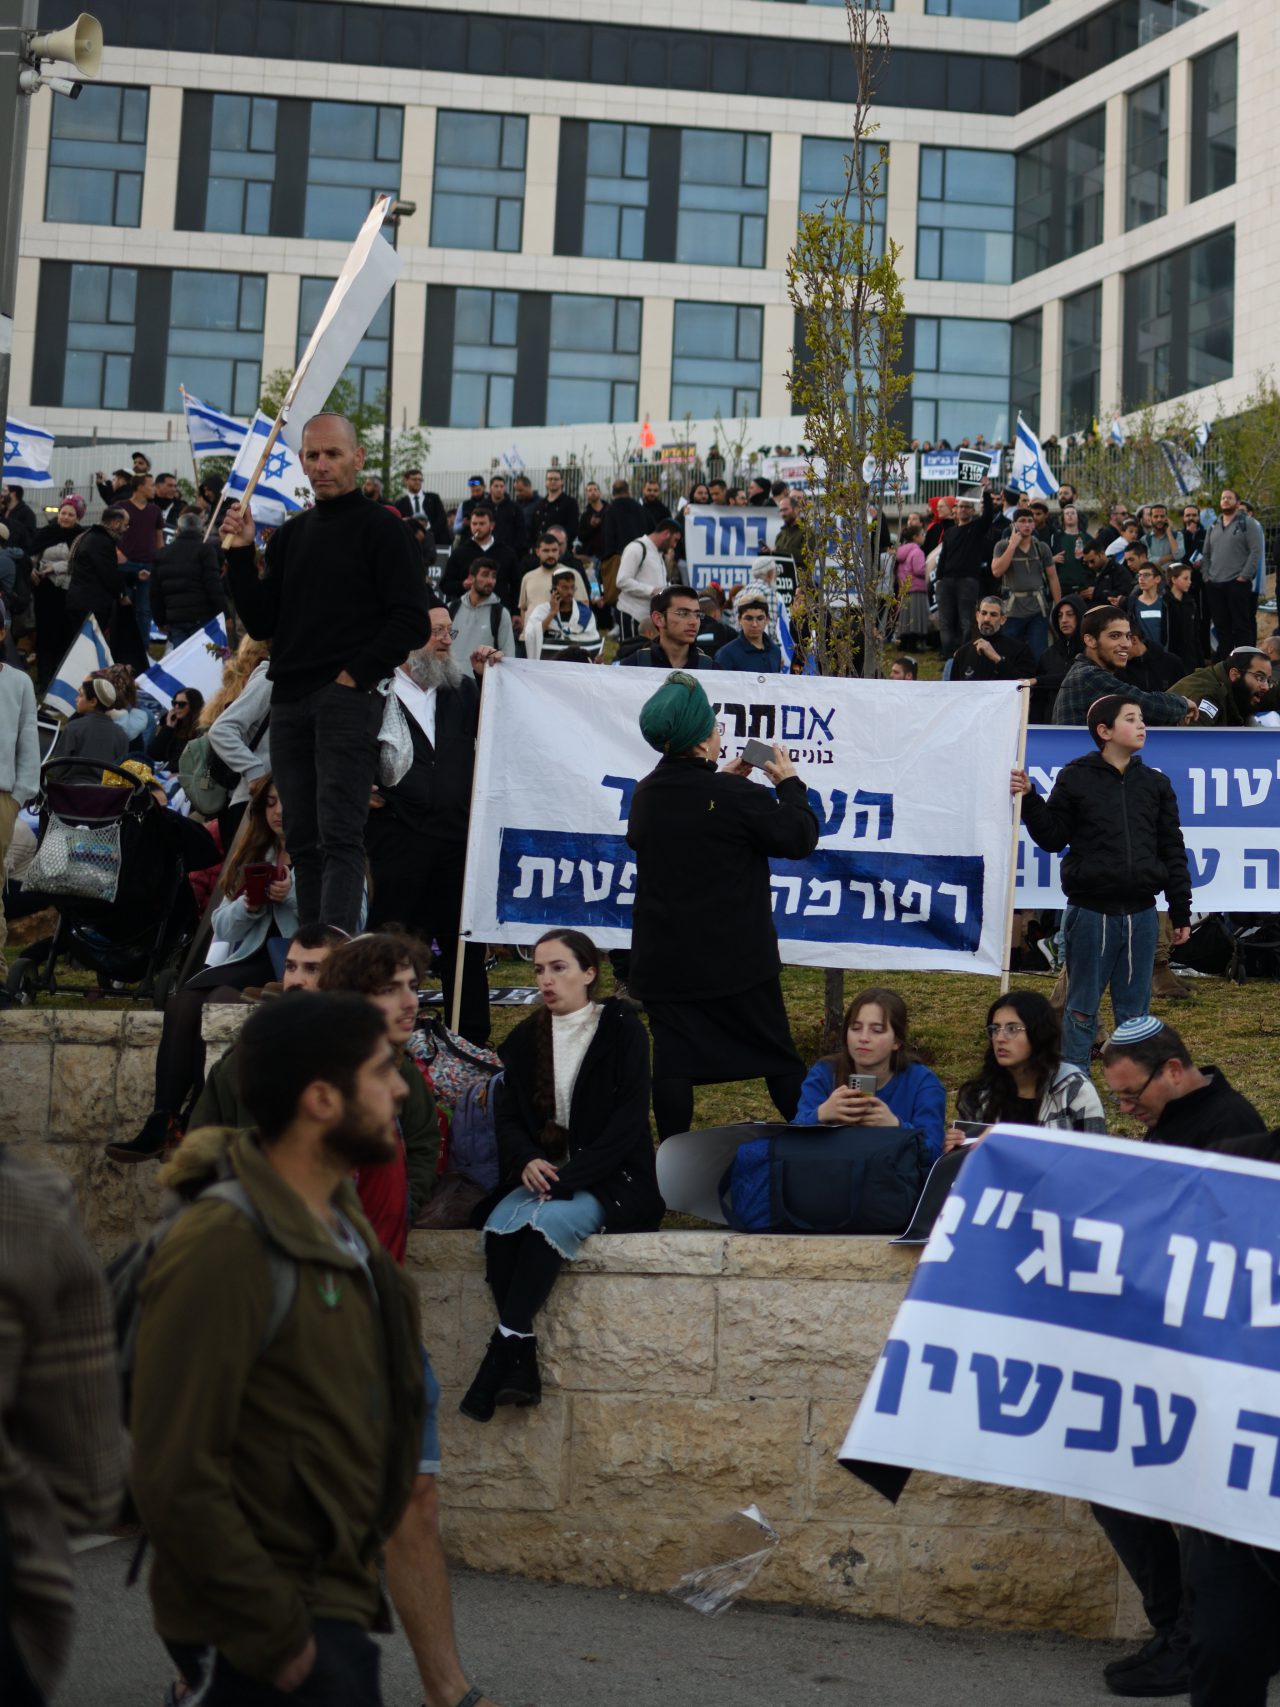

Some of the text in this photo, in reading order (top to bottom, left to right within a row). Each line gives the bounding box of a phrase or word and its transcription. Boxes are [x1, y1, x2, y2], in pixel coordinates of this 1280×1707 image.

[696, 567, 752, 590] פטית
[788, 748, 834, 764] בונים
[512, 854, 968, 924] רפורמה פטית
[874, 1338, 1197, 1467] עכשיו
